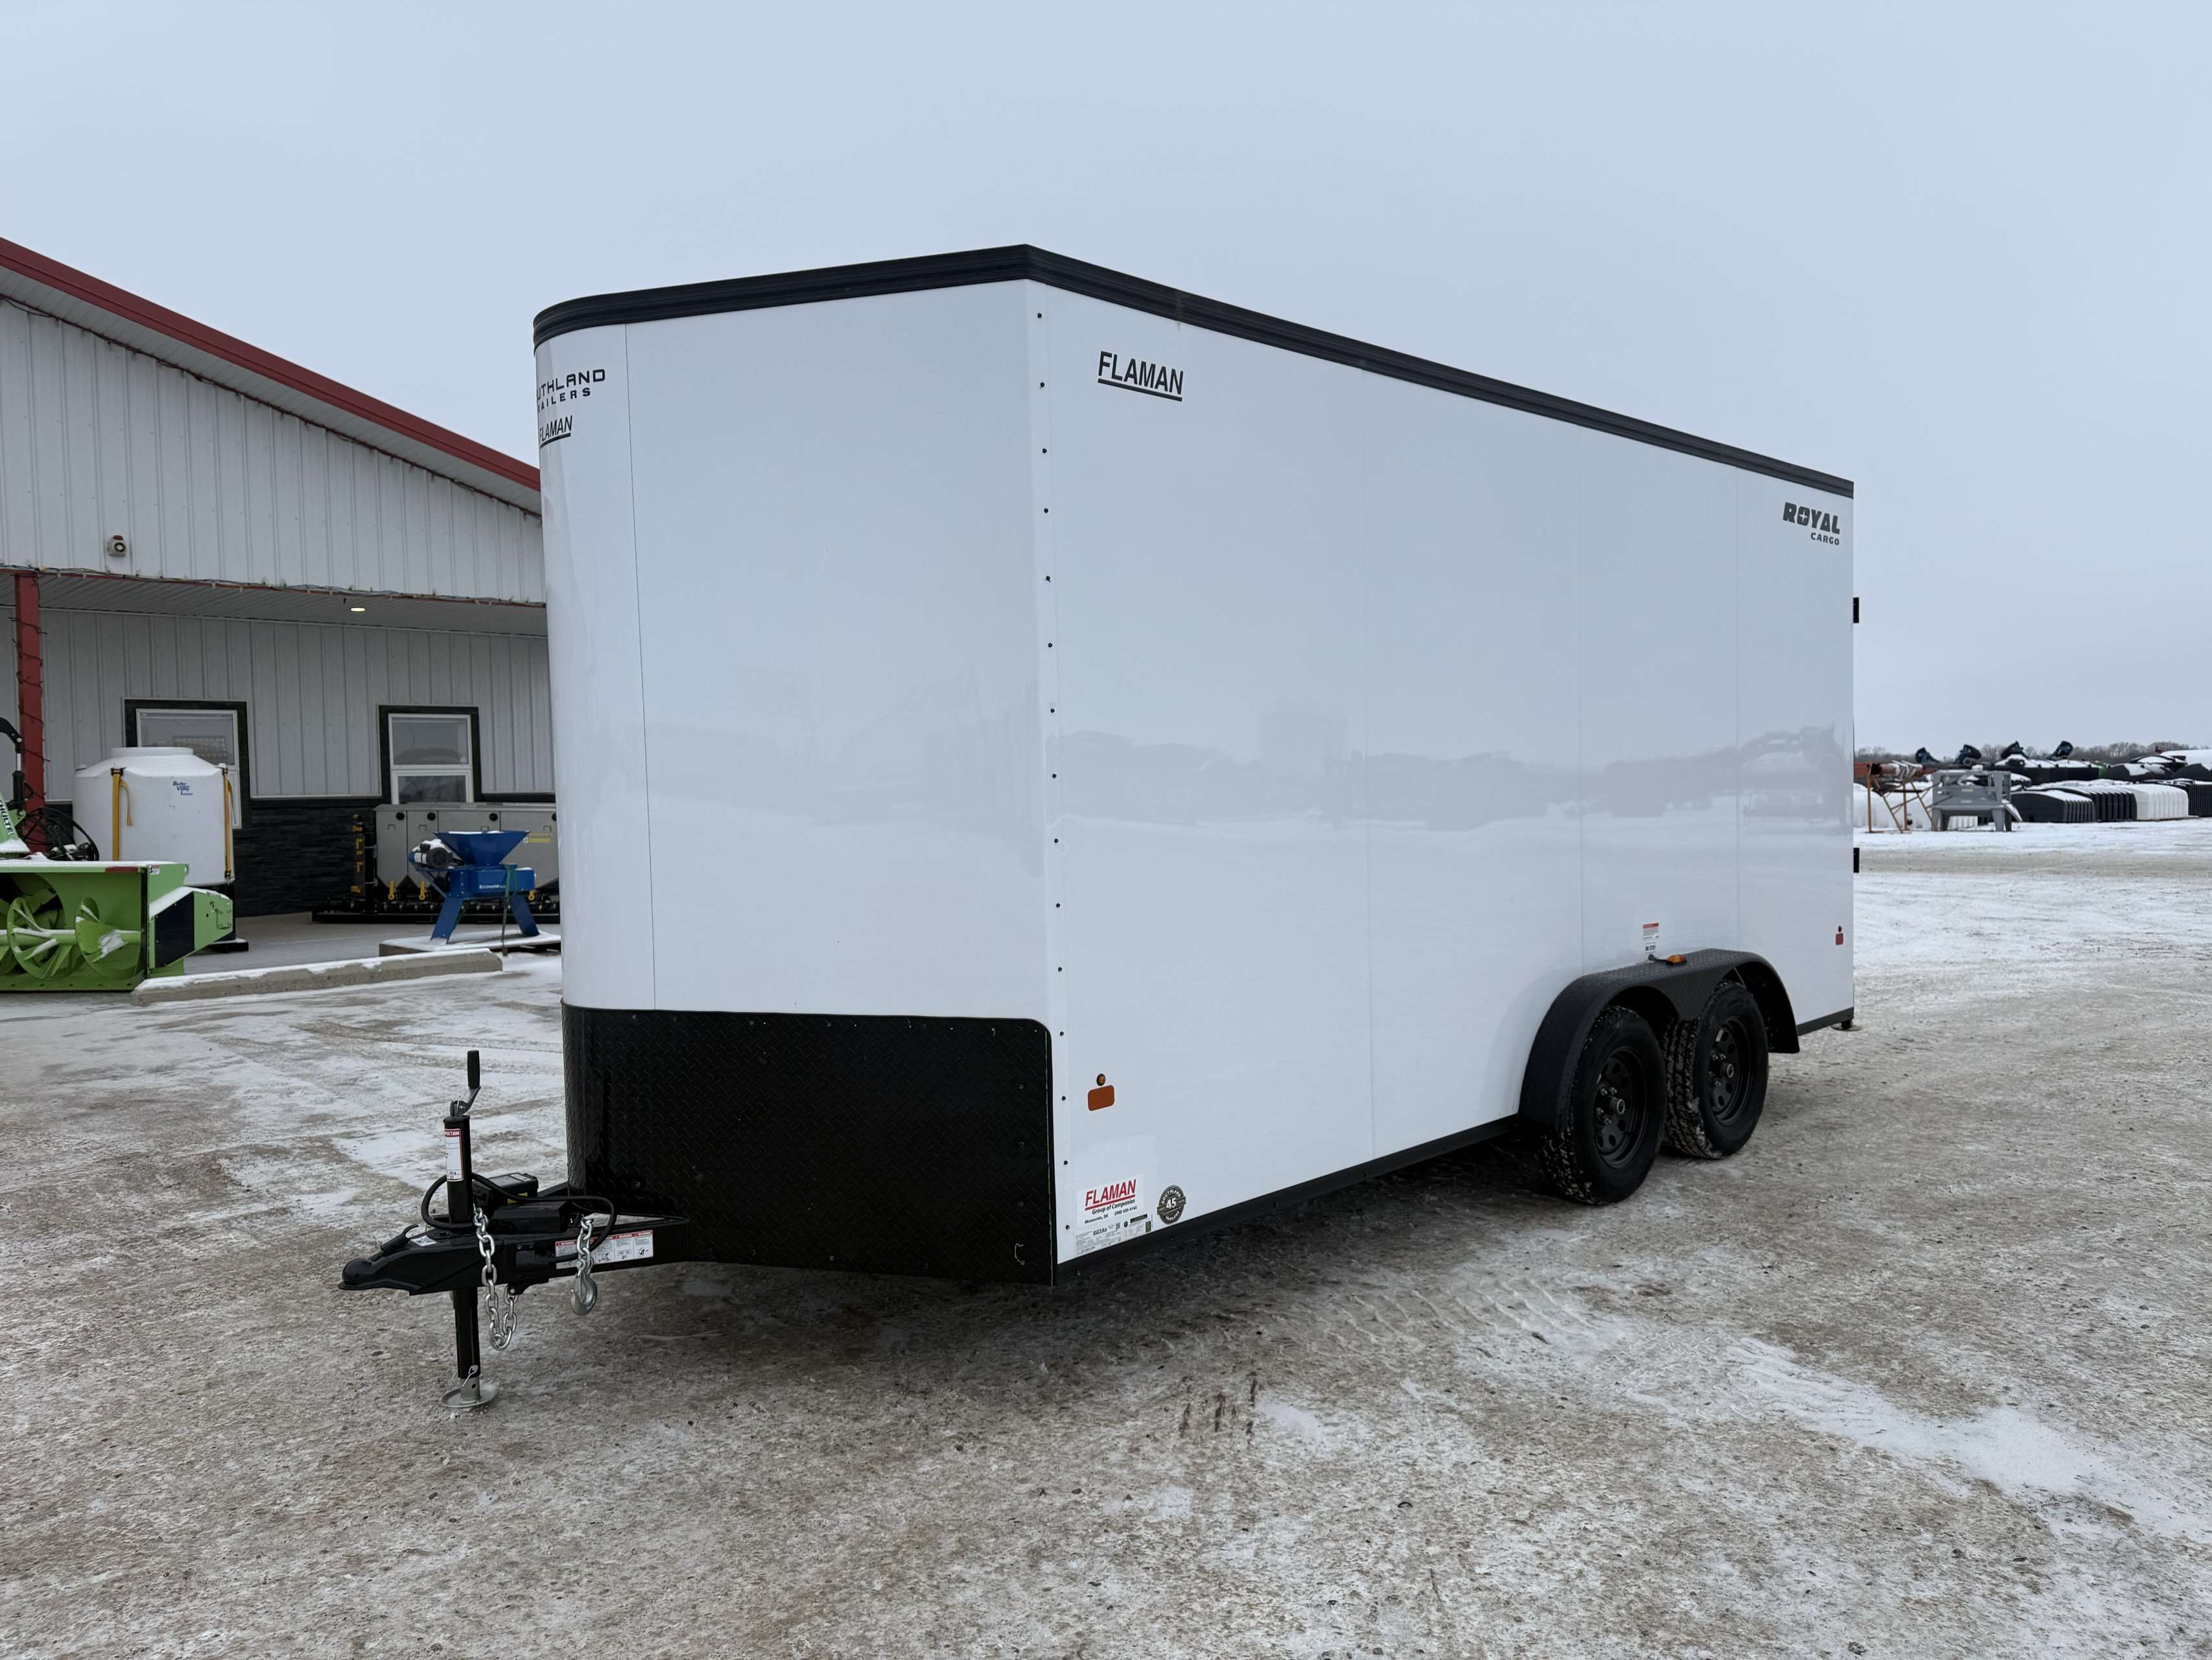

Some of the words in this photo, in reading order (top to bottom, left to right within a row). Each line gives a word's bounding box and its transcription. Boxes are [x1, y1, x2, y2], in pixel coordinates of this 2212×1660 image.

[1098, 351, 1183, 395] FLAMAN
[1783, 502, 1840, 534] ROYAL
[1811, 532, 1839, 545] CARGO
[1085, 1179, 1136, 1207] FLAMAN
[1166, 1197, 1177, 1209] 45
[1112, 1198, 1136, 1209] Companies
